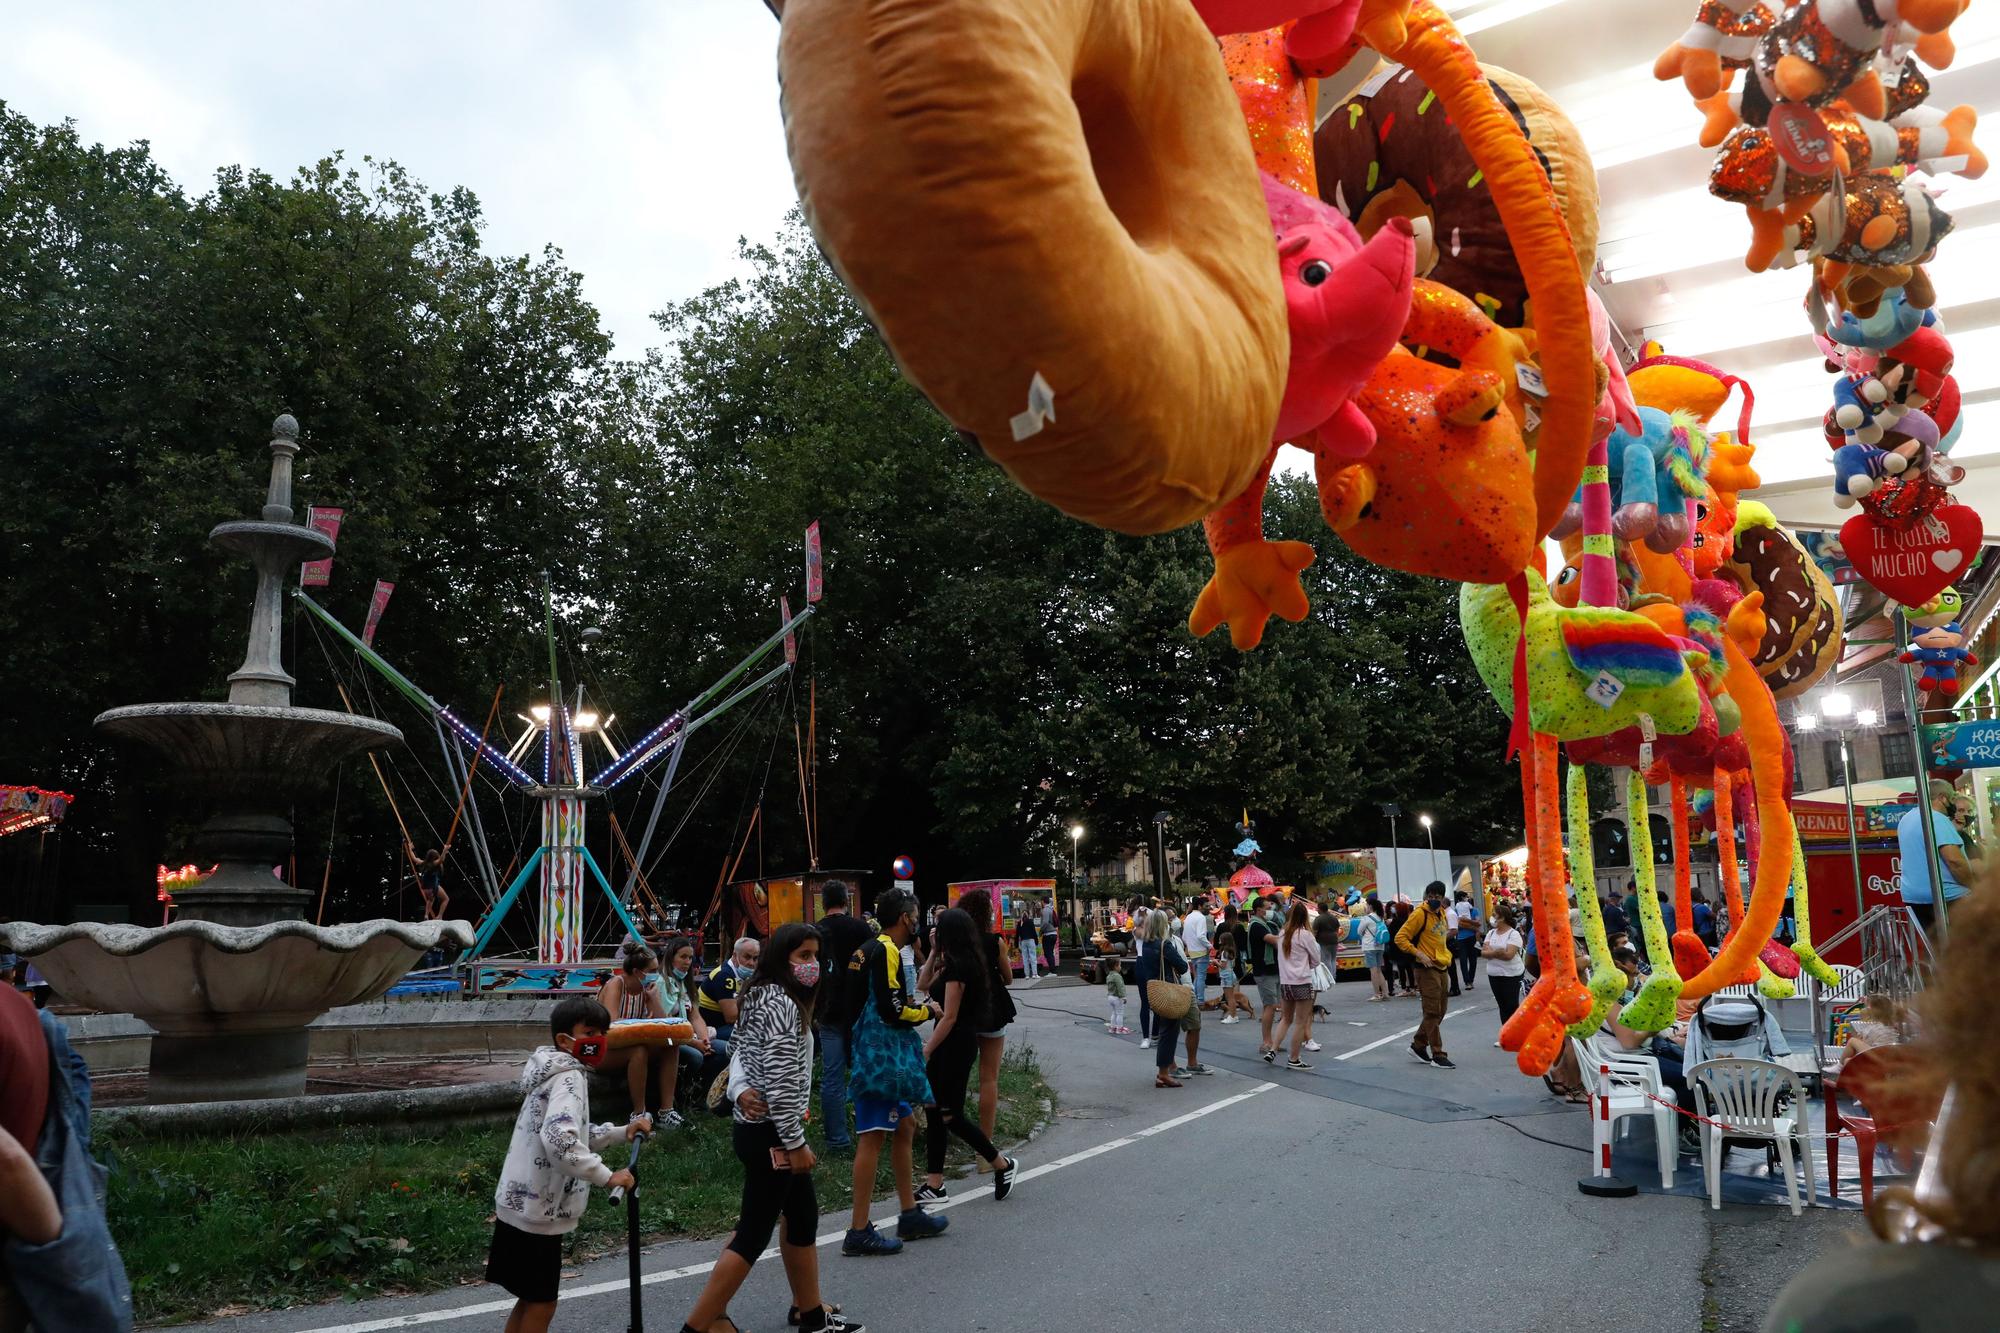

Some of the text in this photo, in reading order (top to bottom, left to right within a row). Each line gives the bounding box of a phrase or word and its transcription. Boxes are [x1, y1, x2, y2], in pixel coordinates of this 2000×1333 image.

[1871, 527, 1887, 549] TE
[1871, 551, 1927, 578] MUCHO
[1796, 814, 1866, 832] RENAUT
